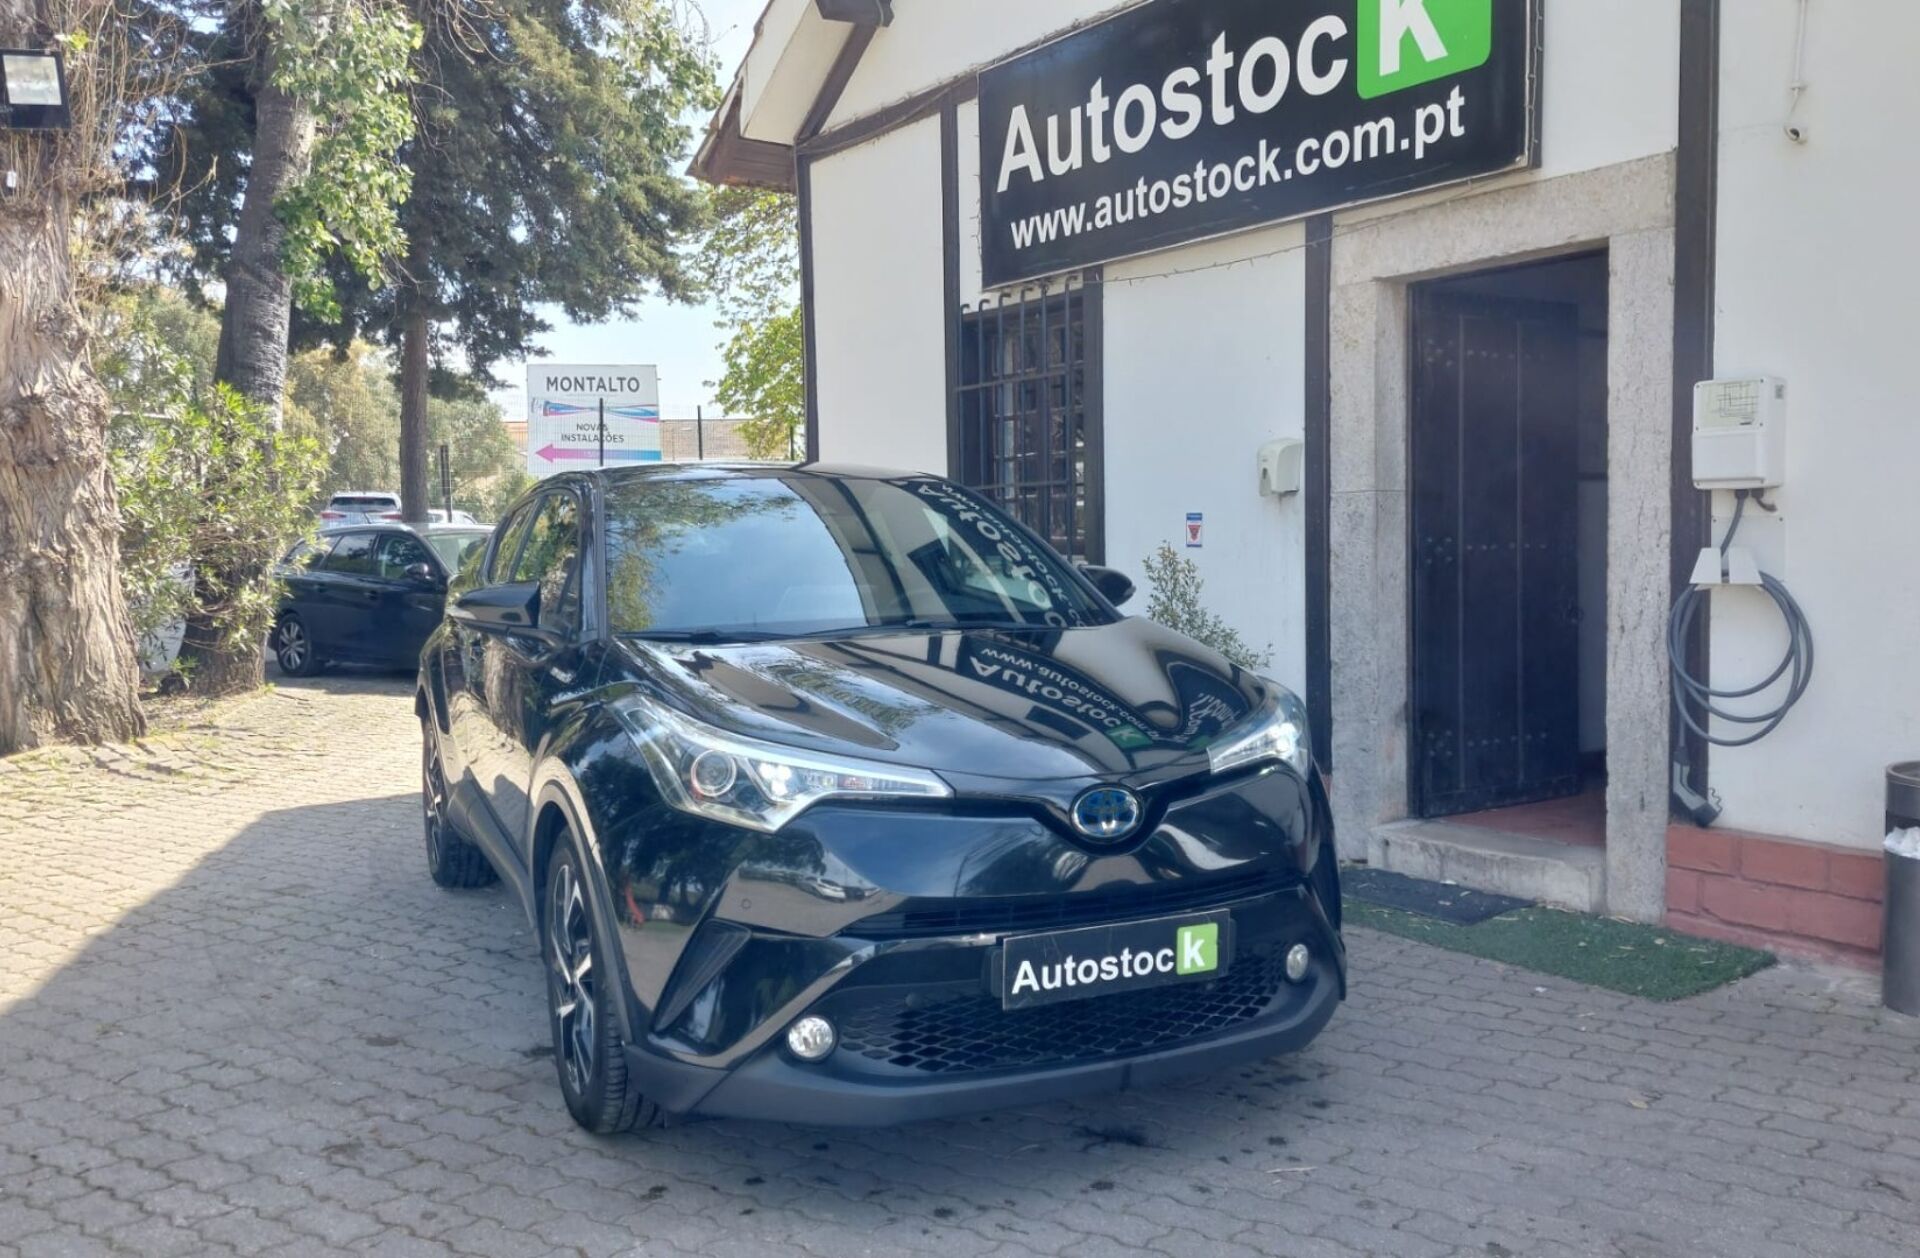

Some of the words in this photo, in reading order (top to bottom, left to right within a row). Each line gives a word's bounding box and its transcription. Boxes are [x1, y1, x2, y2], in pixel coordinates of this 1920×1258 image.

[996, 0, 1449, 193] Autostock
[1010, 85, 1465, 249] www.autostock.com.pt
[546, 376, 640, 393] MONTALTO
[561, 431, 625, 443] INSTALAÕES
[1011, 931, 1206, 995] Autostock
